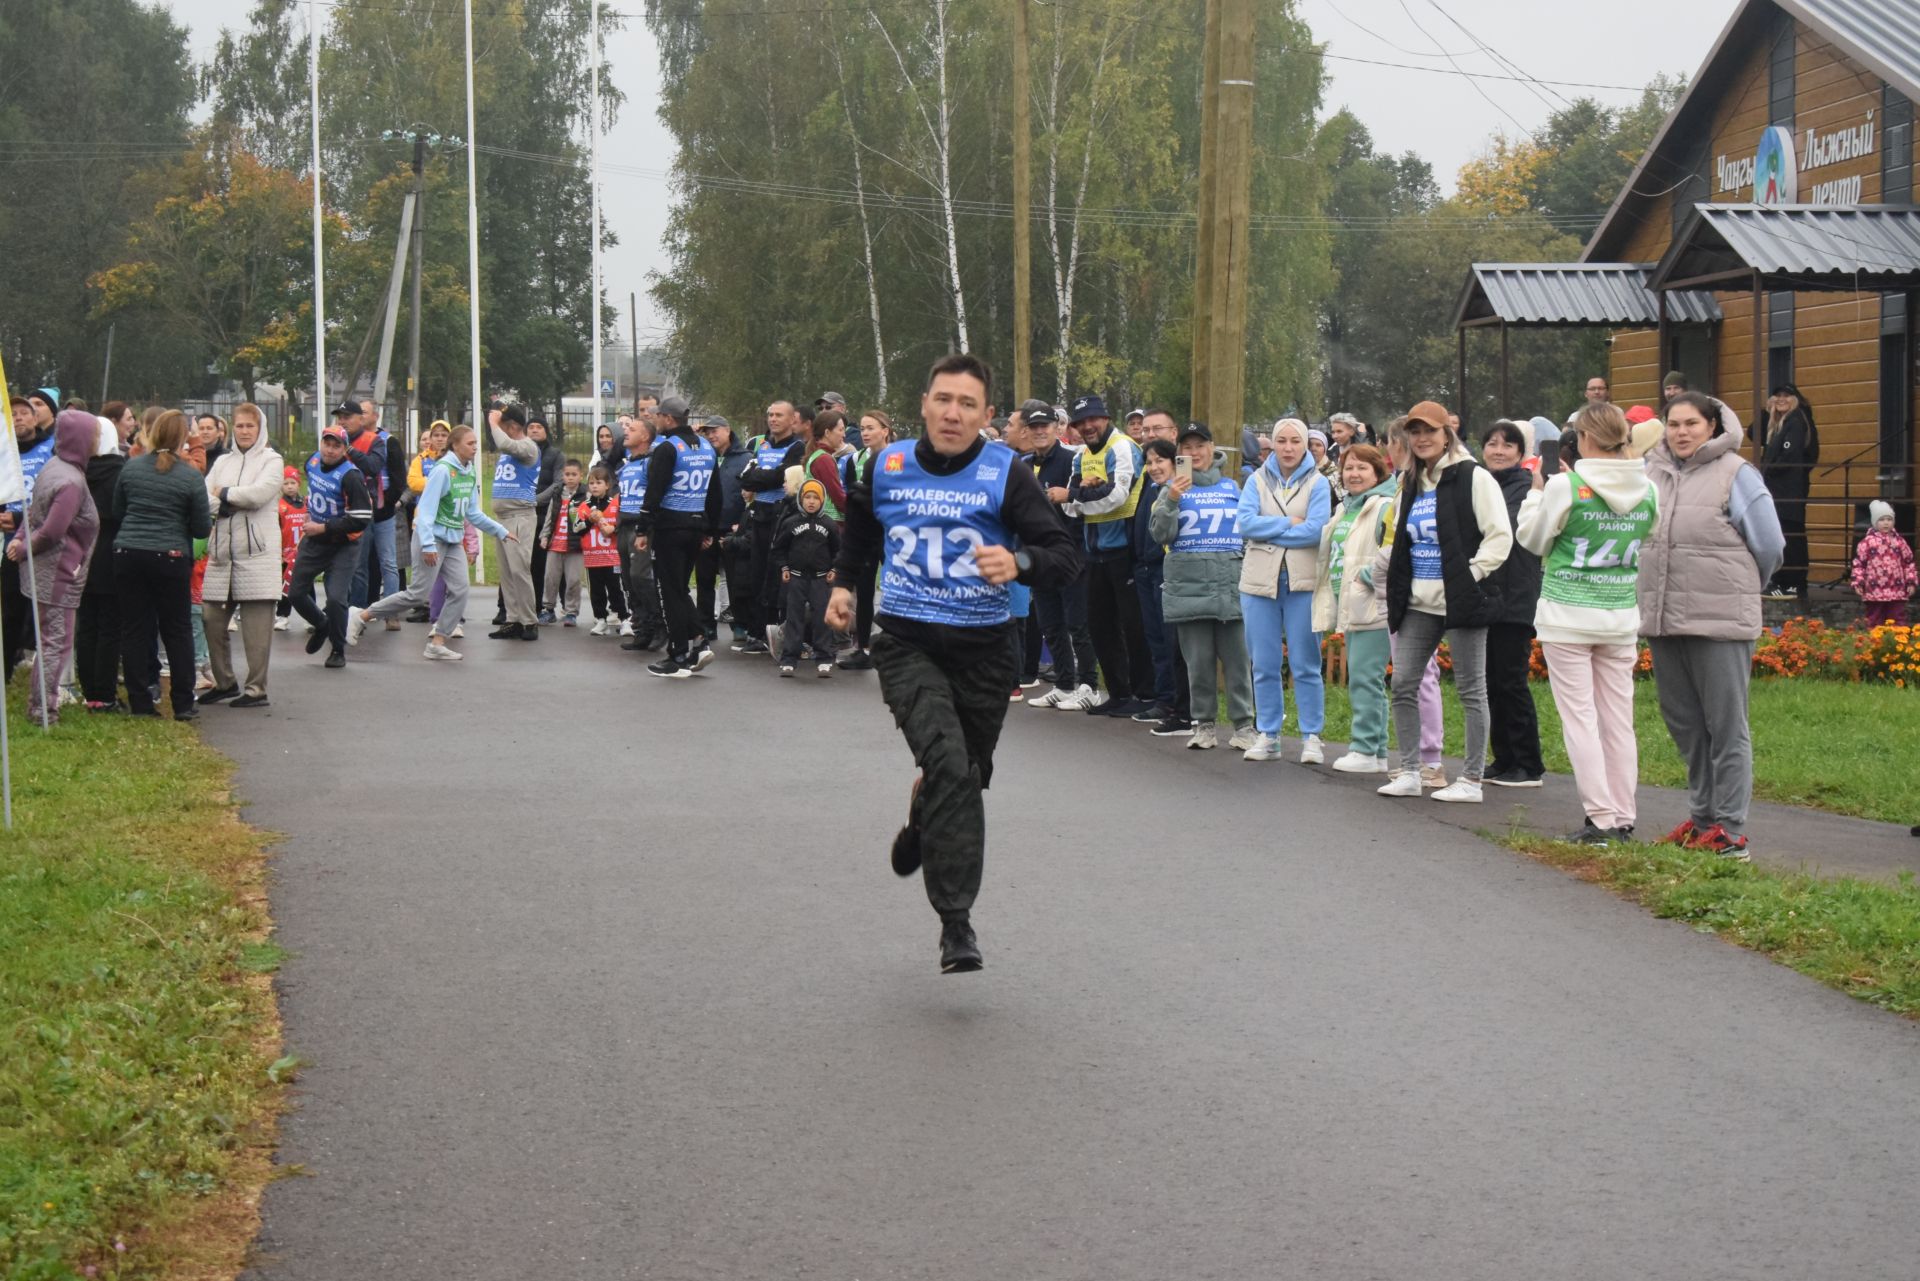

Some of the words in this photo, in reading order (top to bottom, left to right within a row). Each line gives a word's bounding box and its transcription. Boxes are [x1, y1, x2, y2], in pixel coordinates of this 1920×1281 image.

[1802, 109, 1874, 171] Лыжный
[672, 469, 712, 490] 207
[889, 489, 988, 506] ТУКАЕВСКИЙ
[907, 503, 961, 518] РАЙОН
[1582, 511, 1649, 521] ТУКАЕВСКИЙ
[1178, 508, 1240, 536] 277
[1598, 521, 1636, 532] РАЙОН
[888, 525, 984, 579] 212
